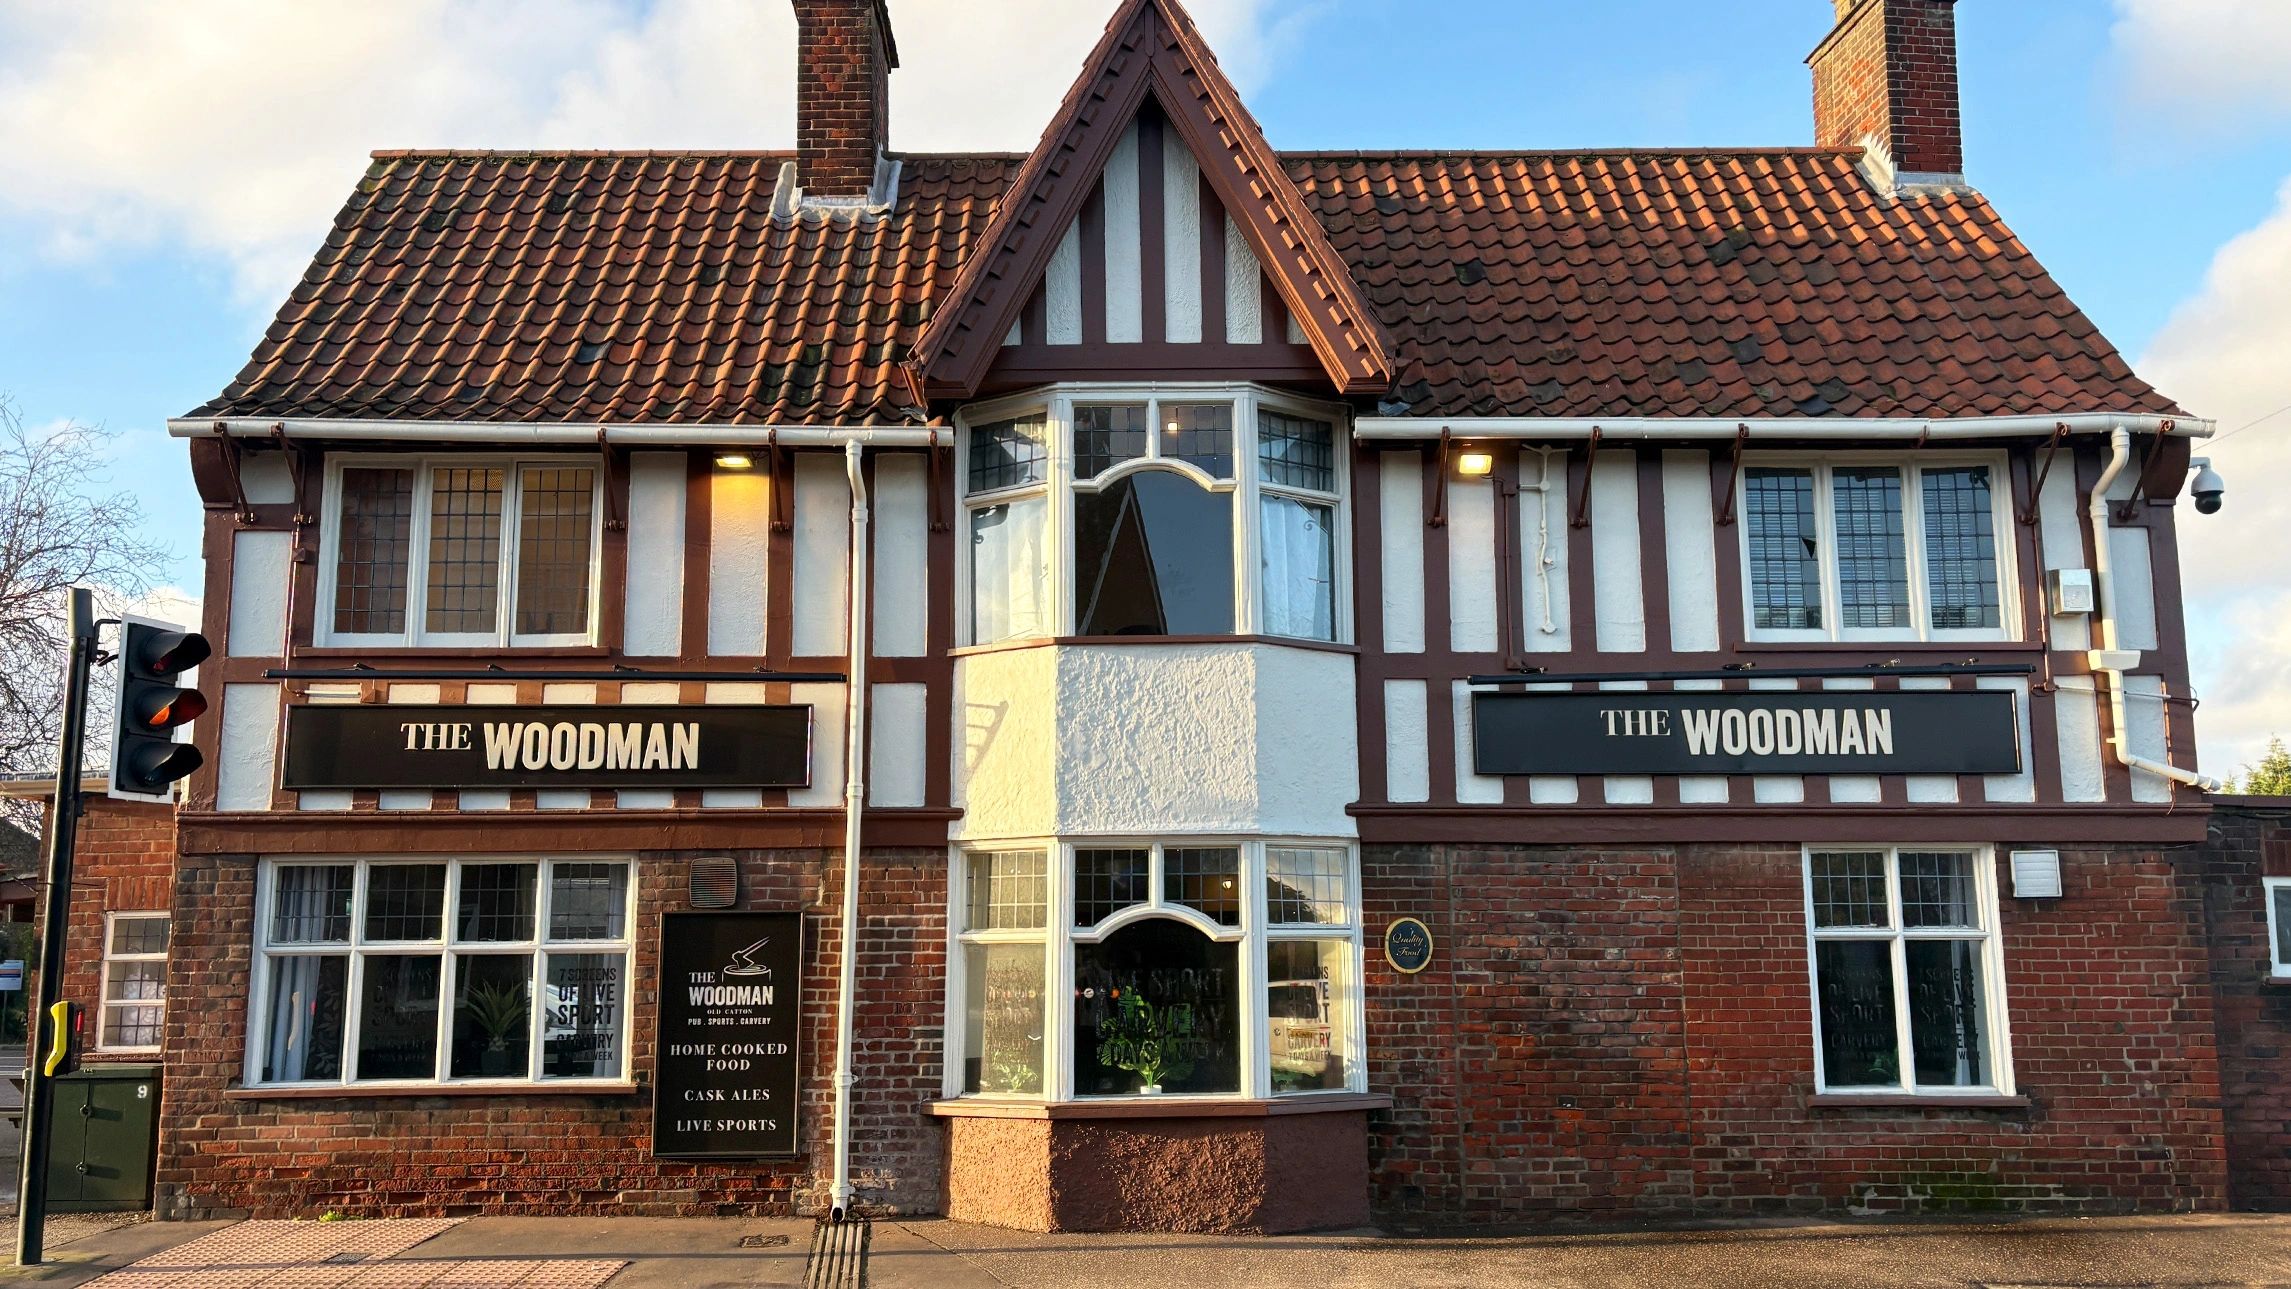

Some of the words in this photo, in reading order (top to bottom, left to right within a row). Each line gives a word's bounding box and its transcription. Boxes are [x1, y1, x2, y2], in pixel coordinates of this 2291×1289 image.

[1600, 709, 1671, 737] THE
[1681, 708, 1894, 756] WOODMAN
[400, 722, 472, 751] THE
[483, 721, 700, 771] WOODMAN
[1393, 930, 1424, 947] Quality
[688, 971, 716, 983] THE
[558, 984, 578, 1002] OF
[688, 985, 774, 1007] WOODMAN
[557, 1004, 616, 1026] SPORT
[688, 1017, 702, 1026] PUB
[707, 1017, 735, 1026] SPORTS
[740, 1017, 771, 1025] CARVERY
[1287, 1032, 1332, 1050] CARVERY
[670, 1044, 716, 1056] HOME
[721, 1043, 788, 1056] COOKED
[706, 1059, 751, 1071] FOOD
[137, 1085, 149, 1099] 9
[684, 1089, 725, 1101] CASK
[731, 1088, 770, 1101] ALES
[676, 1119, 712, 1132] LIVE
[717, 1118, 777, 1131] SPORTS
